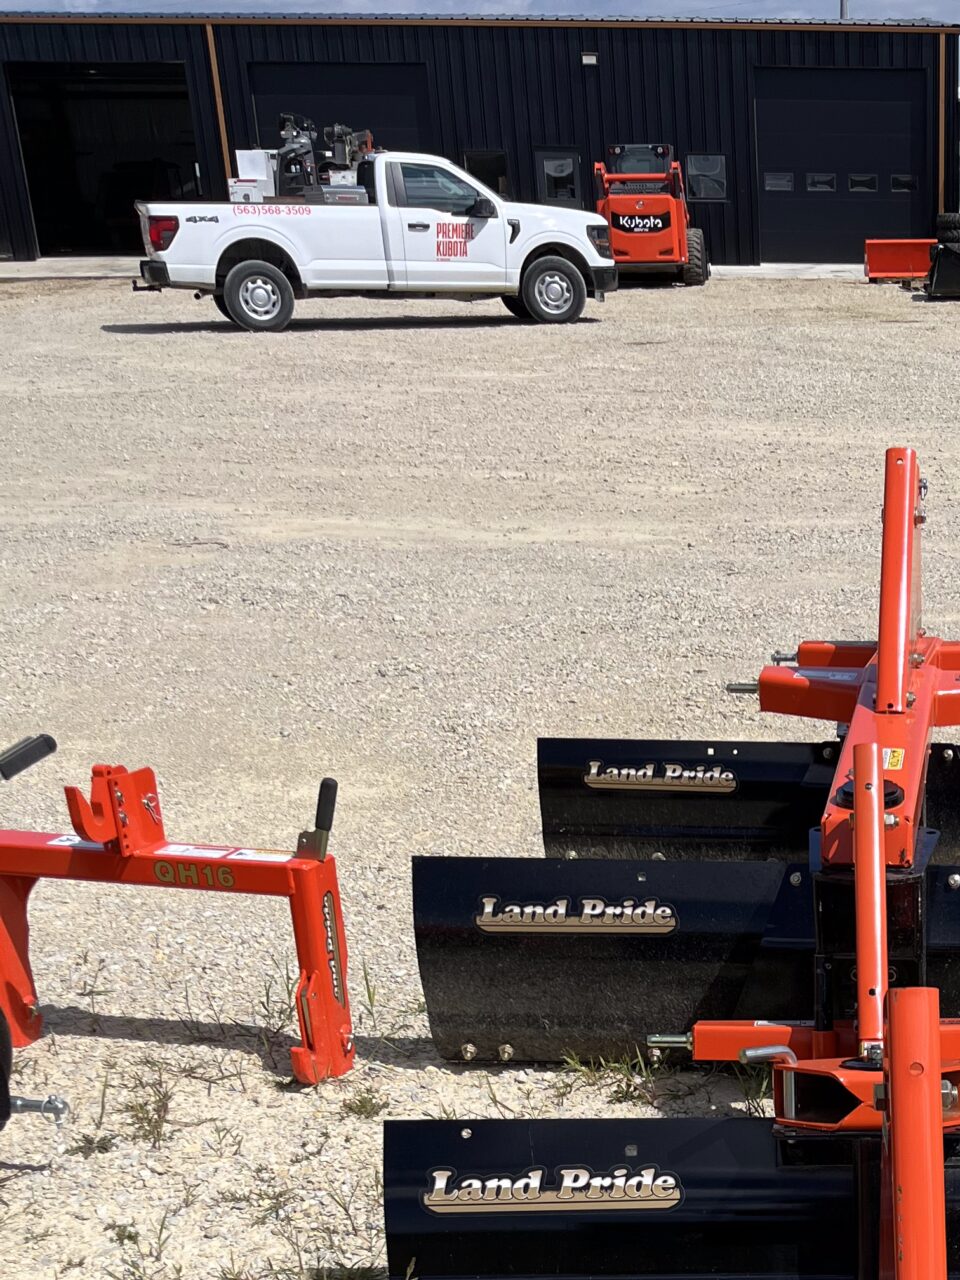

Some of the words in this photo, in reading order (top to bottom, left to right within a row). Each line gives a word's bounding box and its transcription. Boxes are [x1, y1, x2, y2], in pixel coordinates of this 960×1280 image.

[232, 205, 311, 216] (563)568-3509
[436, 223, 475, 239] PREMIERE
[619, 215, 662, 228] Kubota
[436, 241, 468, 257] KUBOTA
[588, 761, 654, 784] Land
[664, 763, 735, 787] Pride
[153, 860, 236, 888] QH16
[479, 896, 568, 925] Land
[579, 898, 674, 926] Pride
[428, 1169, 542, 1201] Land
[557, 1167, 676, 1200] Pride
